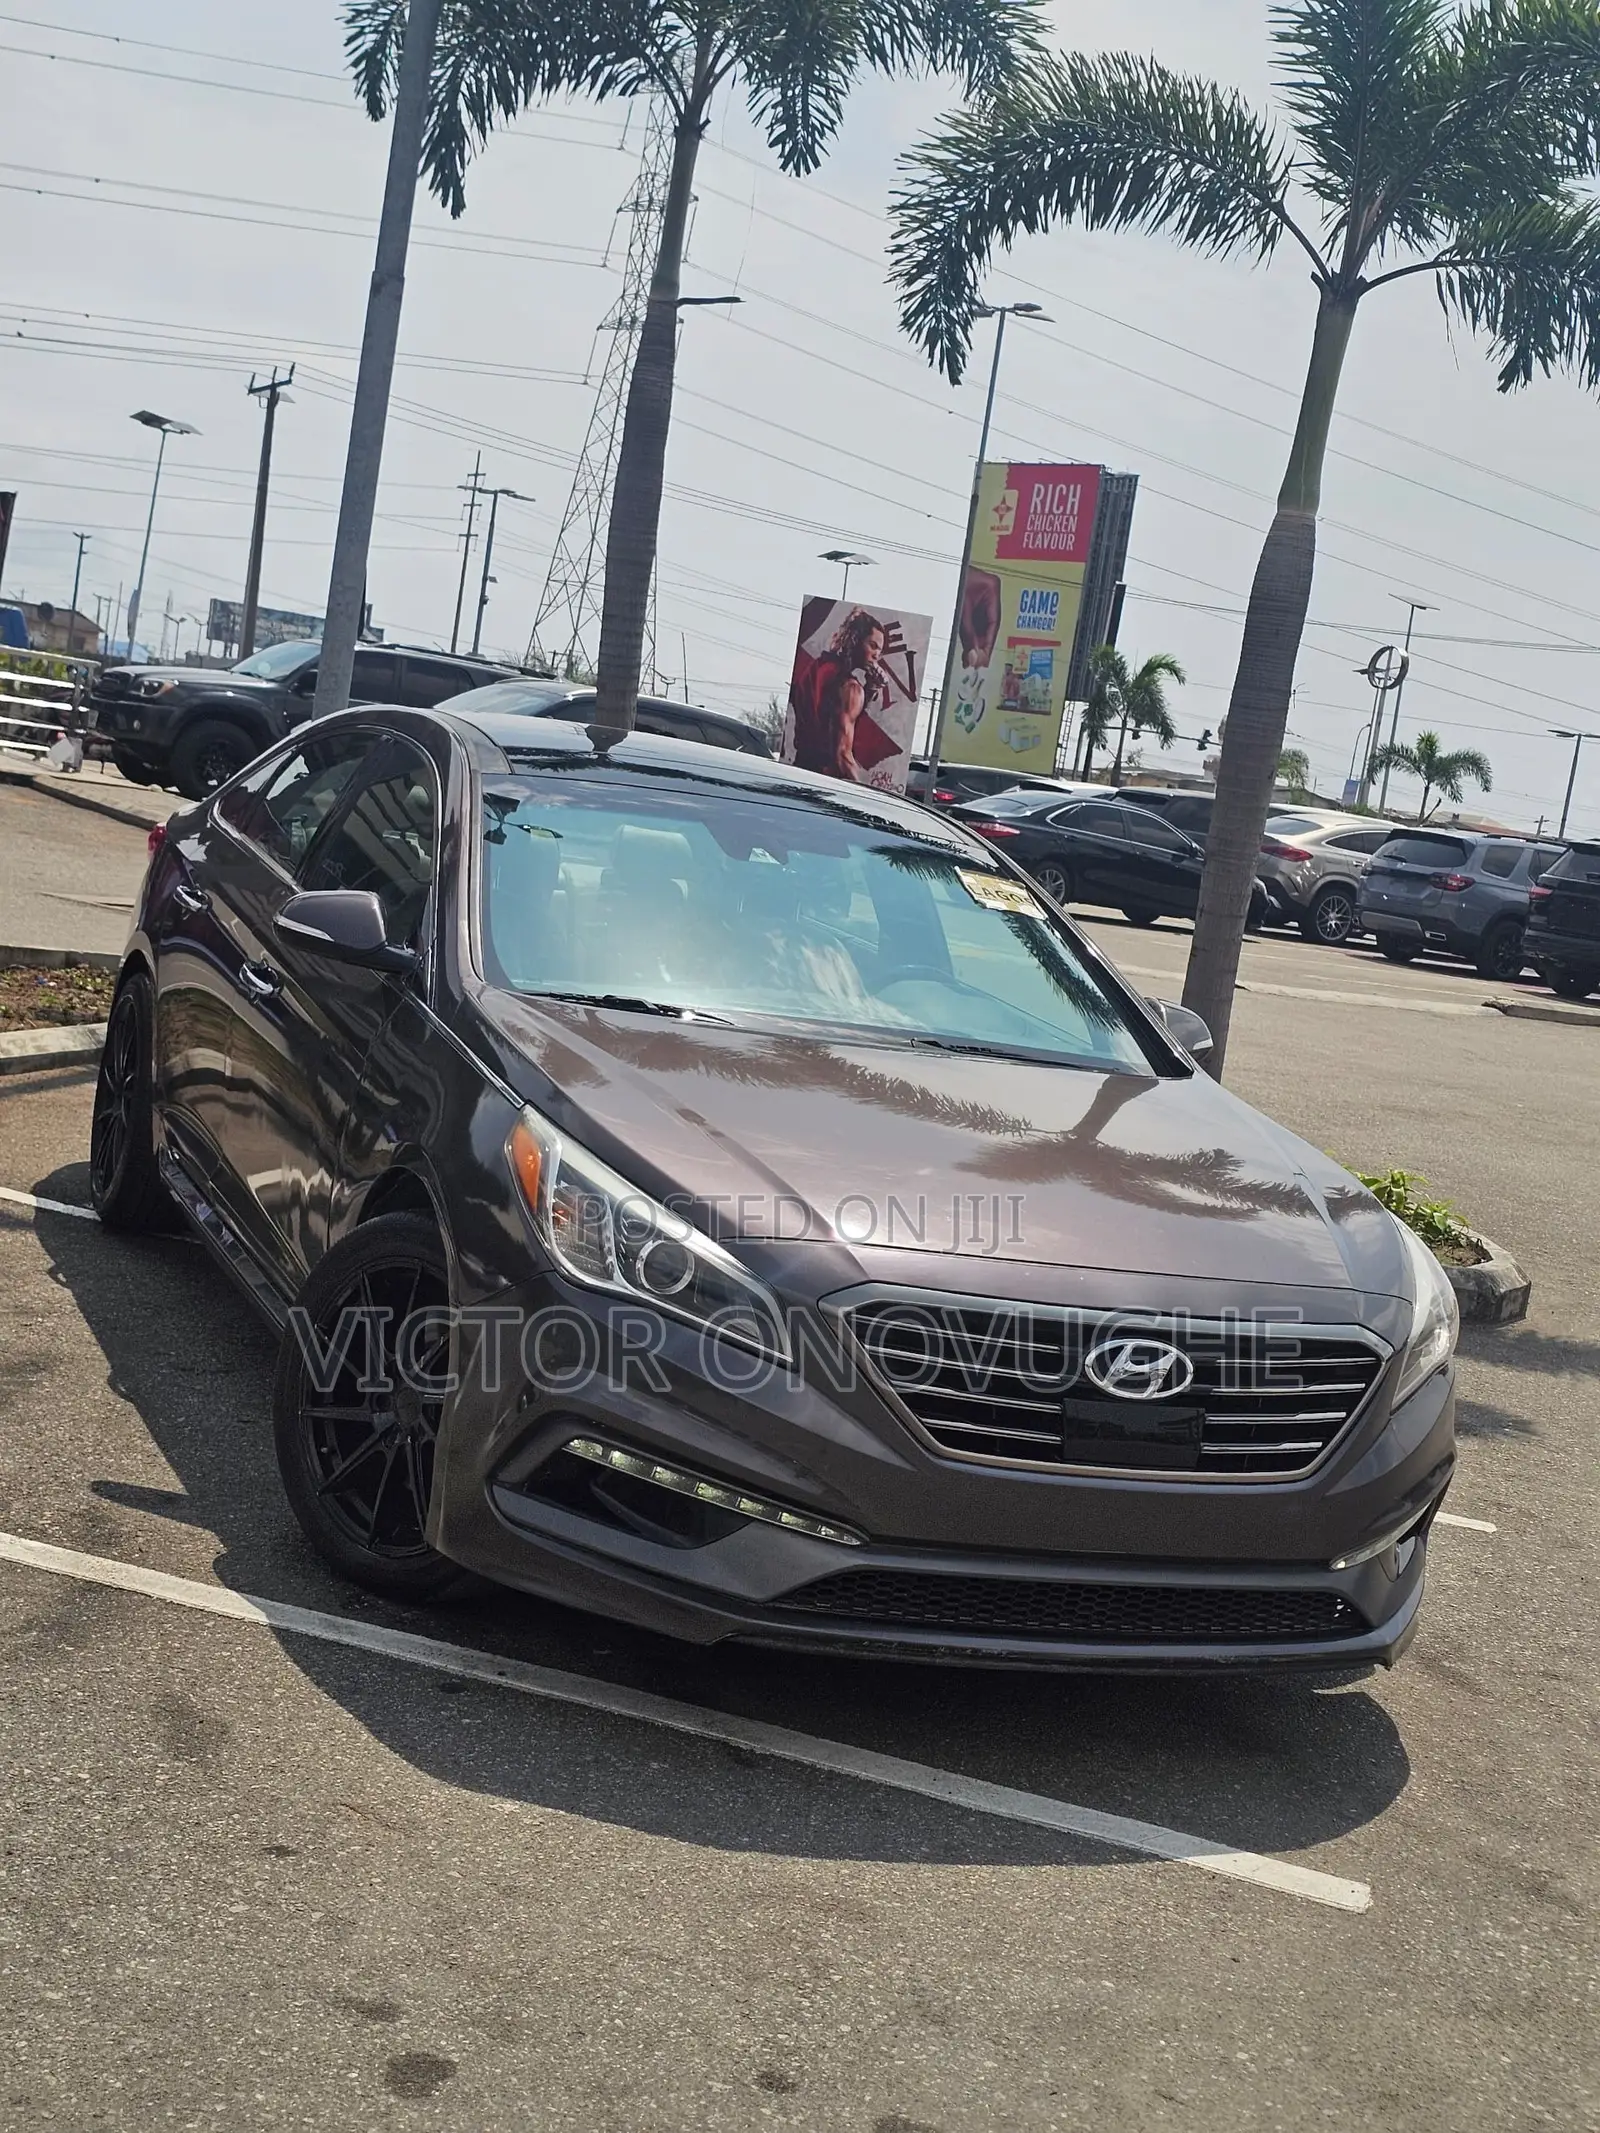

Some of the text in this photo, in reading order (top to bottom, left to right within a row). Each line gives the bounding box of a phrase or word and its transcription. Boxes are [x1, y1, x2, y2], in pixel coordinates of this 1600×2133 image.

[1030, 483, 1081, 515] RICH
[1026, 514, 1077, 532] CHICKEN
[1023, 532, 1075, 551] FLAVOUR
